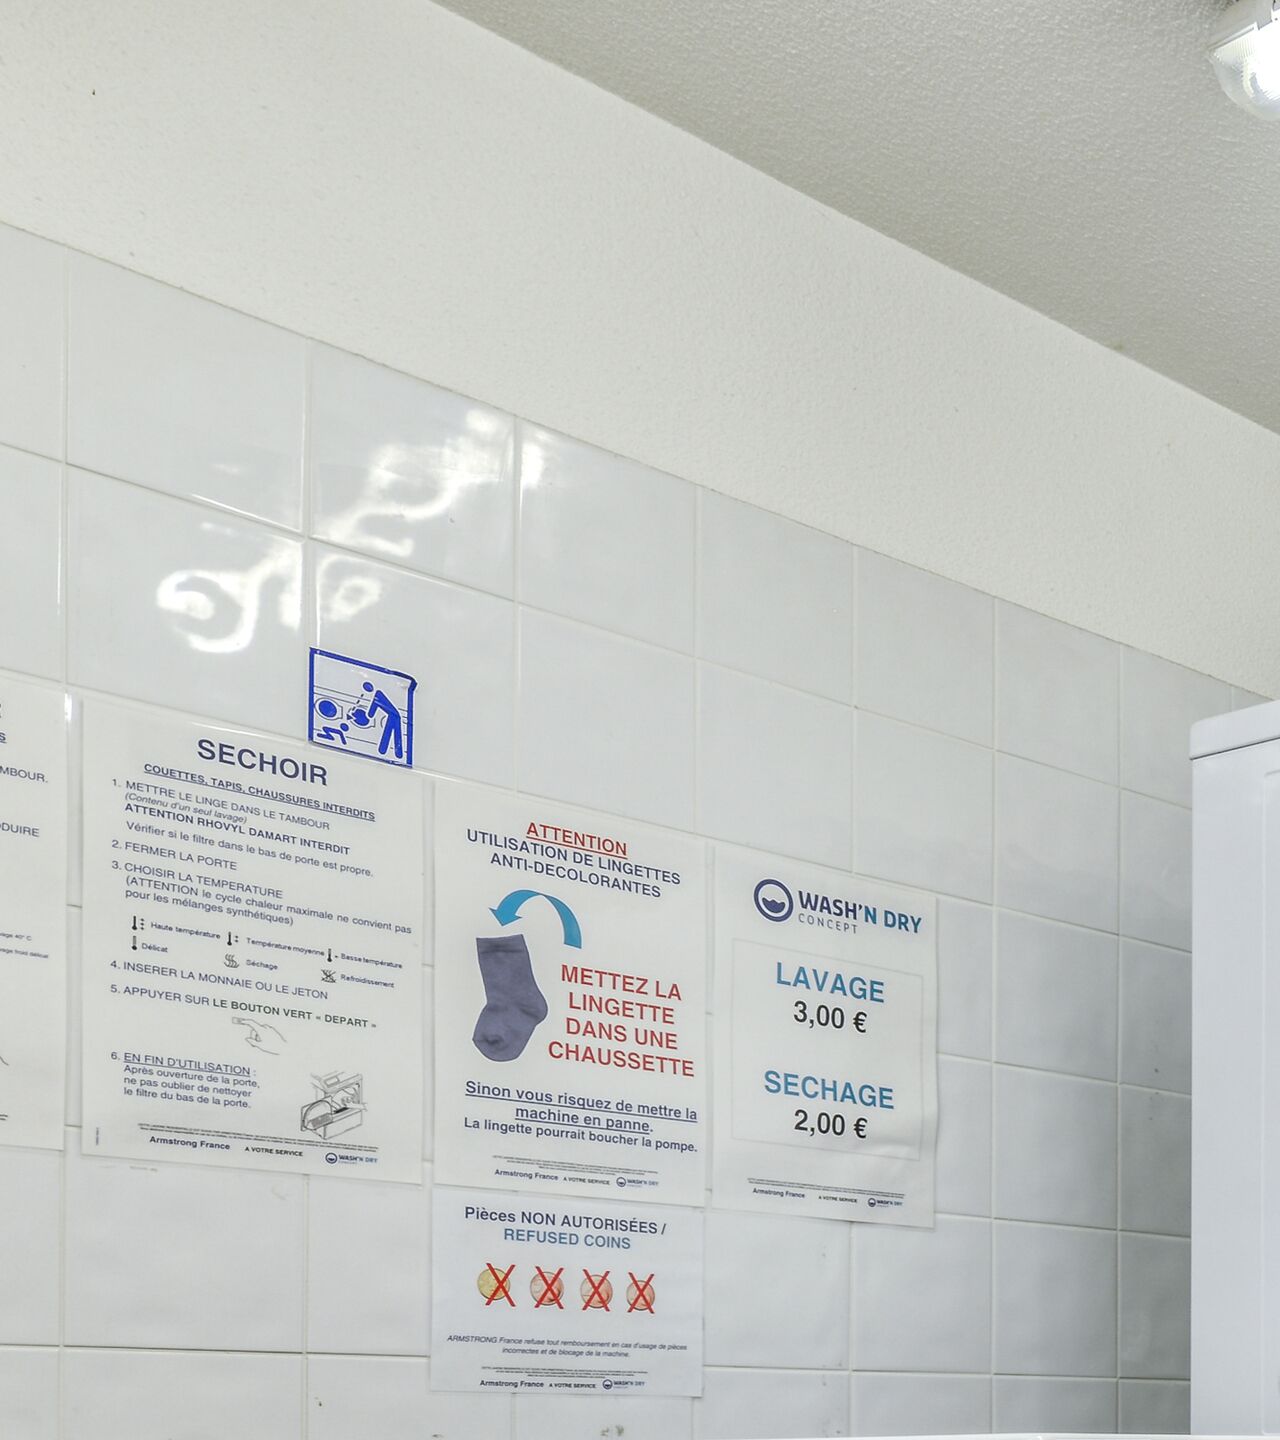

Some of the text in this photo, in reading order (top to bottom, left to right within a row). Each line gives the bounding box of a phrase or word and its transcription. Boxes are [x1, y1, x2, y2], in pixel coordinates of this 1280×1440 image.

[197, 738, 327, 786] SECHOIR
[112, 778, 330, 830] 1. METTRE LE LINGE DANS LE TAMBOUR
[142, 761, 375, 819] COUETTES, TAPIS, CHAUSSURES INTERDITS
[0, 822, 40, 838] DUIRE
[124, 802, 350, 855] ATTENTION RHOVYL DAMART INTERDIT
[526, 822, 627, 856] ATTENTION
[111, 838, 236, 870] 2. FERMER LA PORTE
[125, 820, 373, 877] Vérifier si le filtre dans le bas de porte est propre.
[467, 828, 680, 885] UTILISATION DE LINGETTES
[111, 860, 282, 899] 3. CHOISIR LA TEMPERATURE
[490, 852, 661, 898] ANTI-DECOLORANTES
[797, 912, 858, 934] CONCEPT
[883, 909, 921, 933] DRY
[110, 960, 328, 999] 4. INSERER LA MONNAIE OU LE JETON
[561, 964, 681, 1001] METTEZ LA
[776, 961, 884, 1003] LAVAGE
[110, 983, 120, 993] 5.
[122, 985, 181, 1002] APPUYER
[184, 994, 209, 1006] SUR
[212, 998, 228, 1008] LE
[230, 1000, 279, 1015] BOUTON
[282, 1008, 311, 1020] VERT
[324, 1013, 368, 1028] DEPART
[569, 991, 674, 1024] LINGETTE
[793, 1000, 867, 1033] 3,00 €
[566, 1016, 677, 1050] DANS UNE
[110, 1051, 120, 1060] 6.
[123, 1052, 141, 1062] EN
[144, 1054, 164, 1065] FIN
[166, 1057, 250, 1075] D'UTILISATION
[548, 1040, 694, 1077] CHAUSSETTE
[465, 1080, 697, 1120] Sinon vous risquez de mettre la
[764, 1070, 894, 1109] SECHAGE
[464, 1116, 697, 1153] La lingette pourrait boucher la pompe.
[515, 1107, 653, 1132] machine en panne.
[794, 1108, 868, 1139] 2,00 €
[149, 1135, 230, 1150] Armstrong France
[464, 1206, 515, 1222] Pièces
[521, 1210, 555, 1226] NON
[560, 1214, 657, 1234] AUTORISÉES
[503, 1227, 631, 1249] REFUSED COINS
